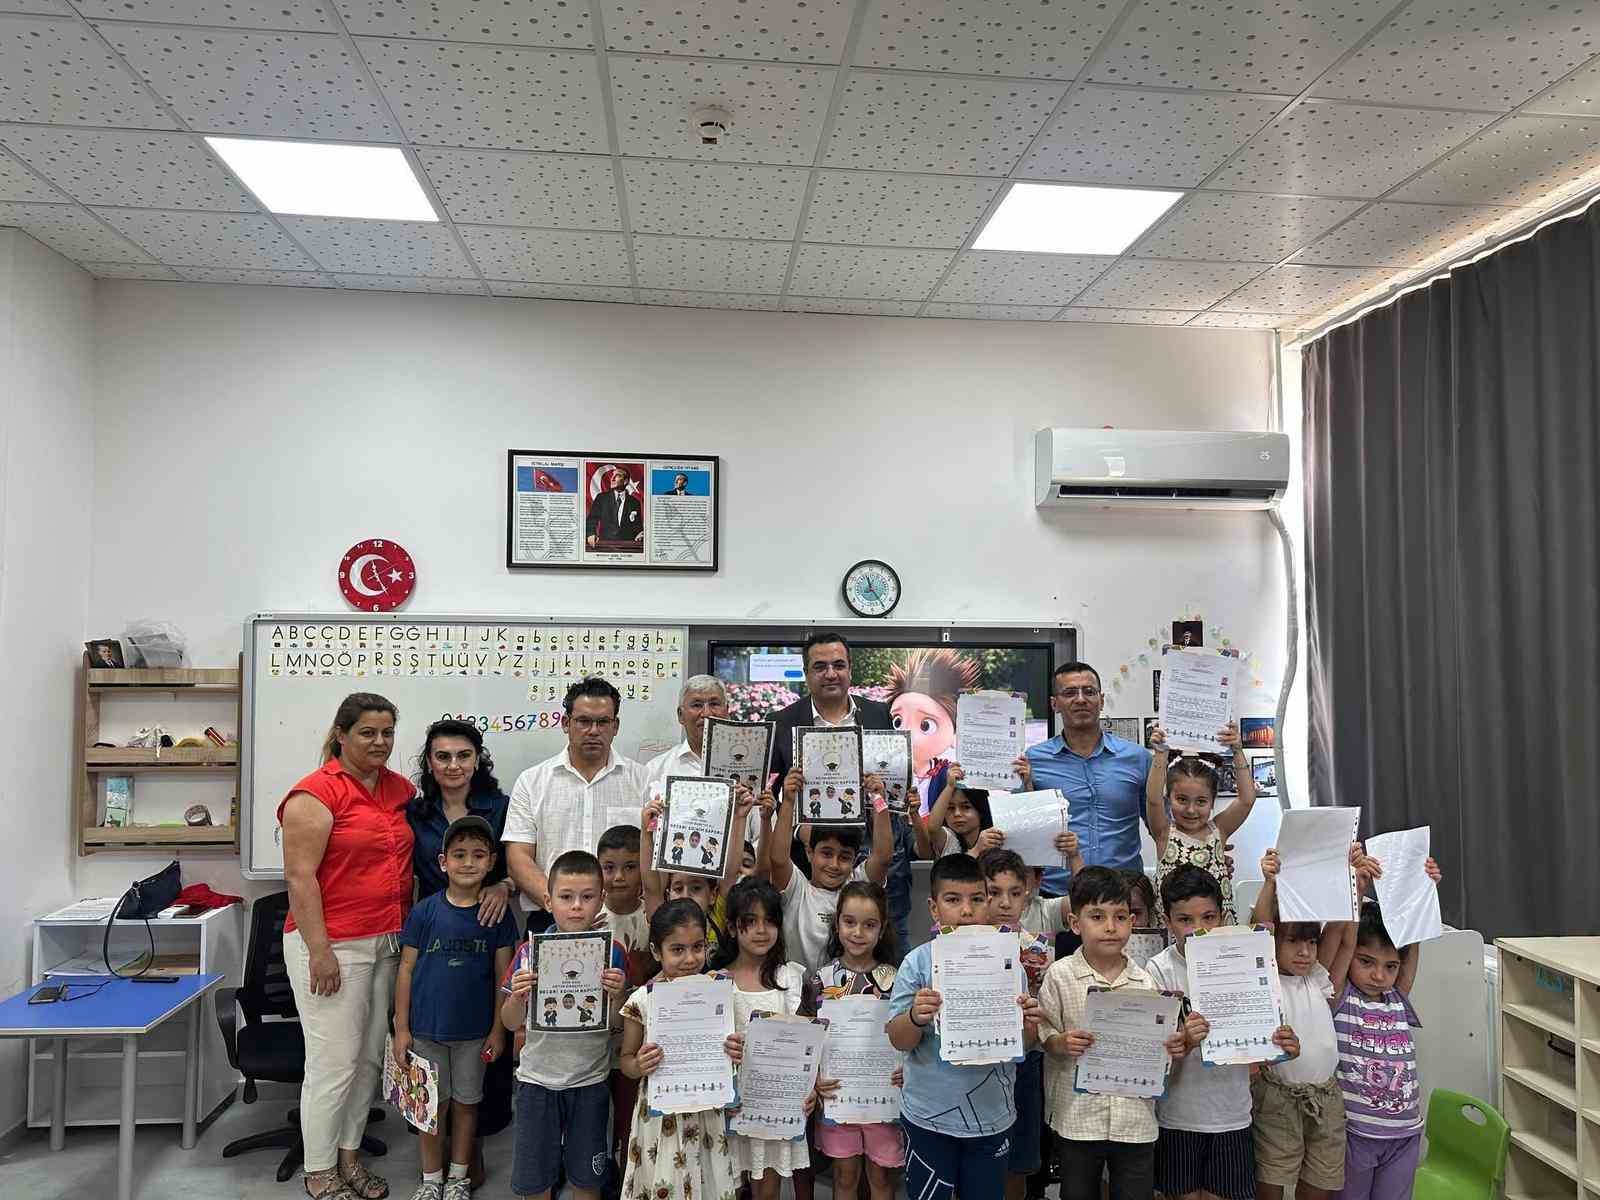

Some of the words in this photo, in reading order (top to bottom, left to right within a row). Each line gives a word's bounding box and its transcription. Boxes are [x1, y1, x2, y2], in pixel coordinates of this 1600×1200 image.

[373, 540, 383, 548] 12
[340, 571, 345, 579] 9
[408, 572, 415, 580] 3
[373, 604, 379, 612] 6
